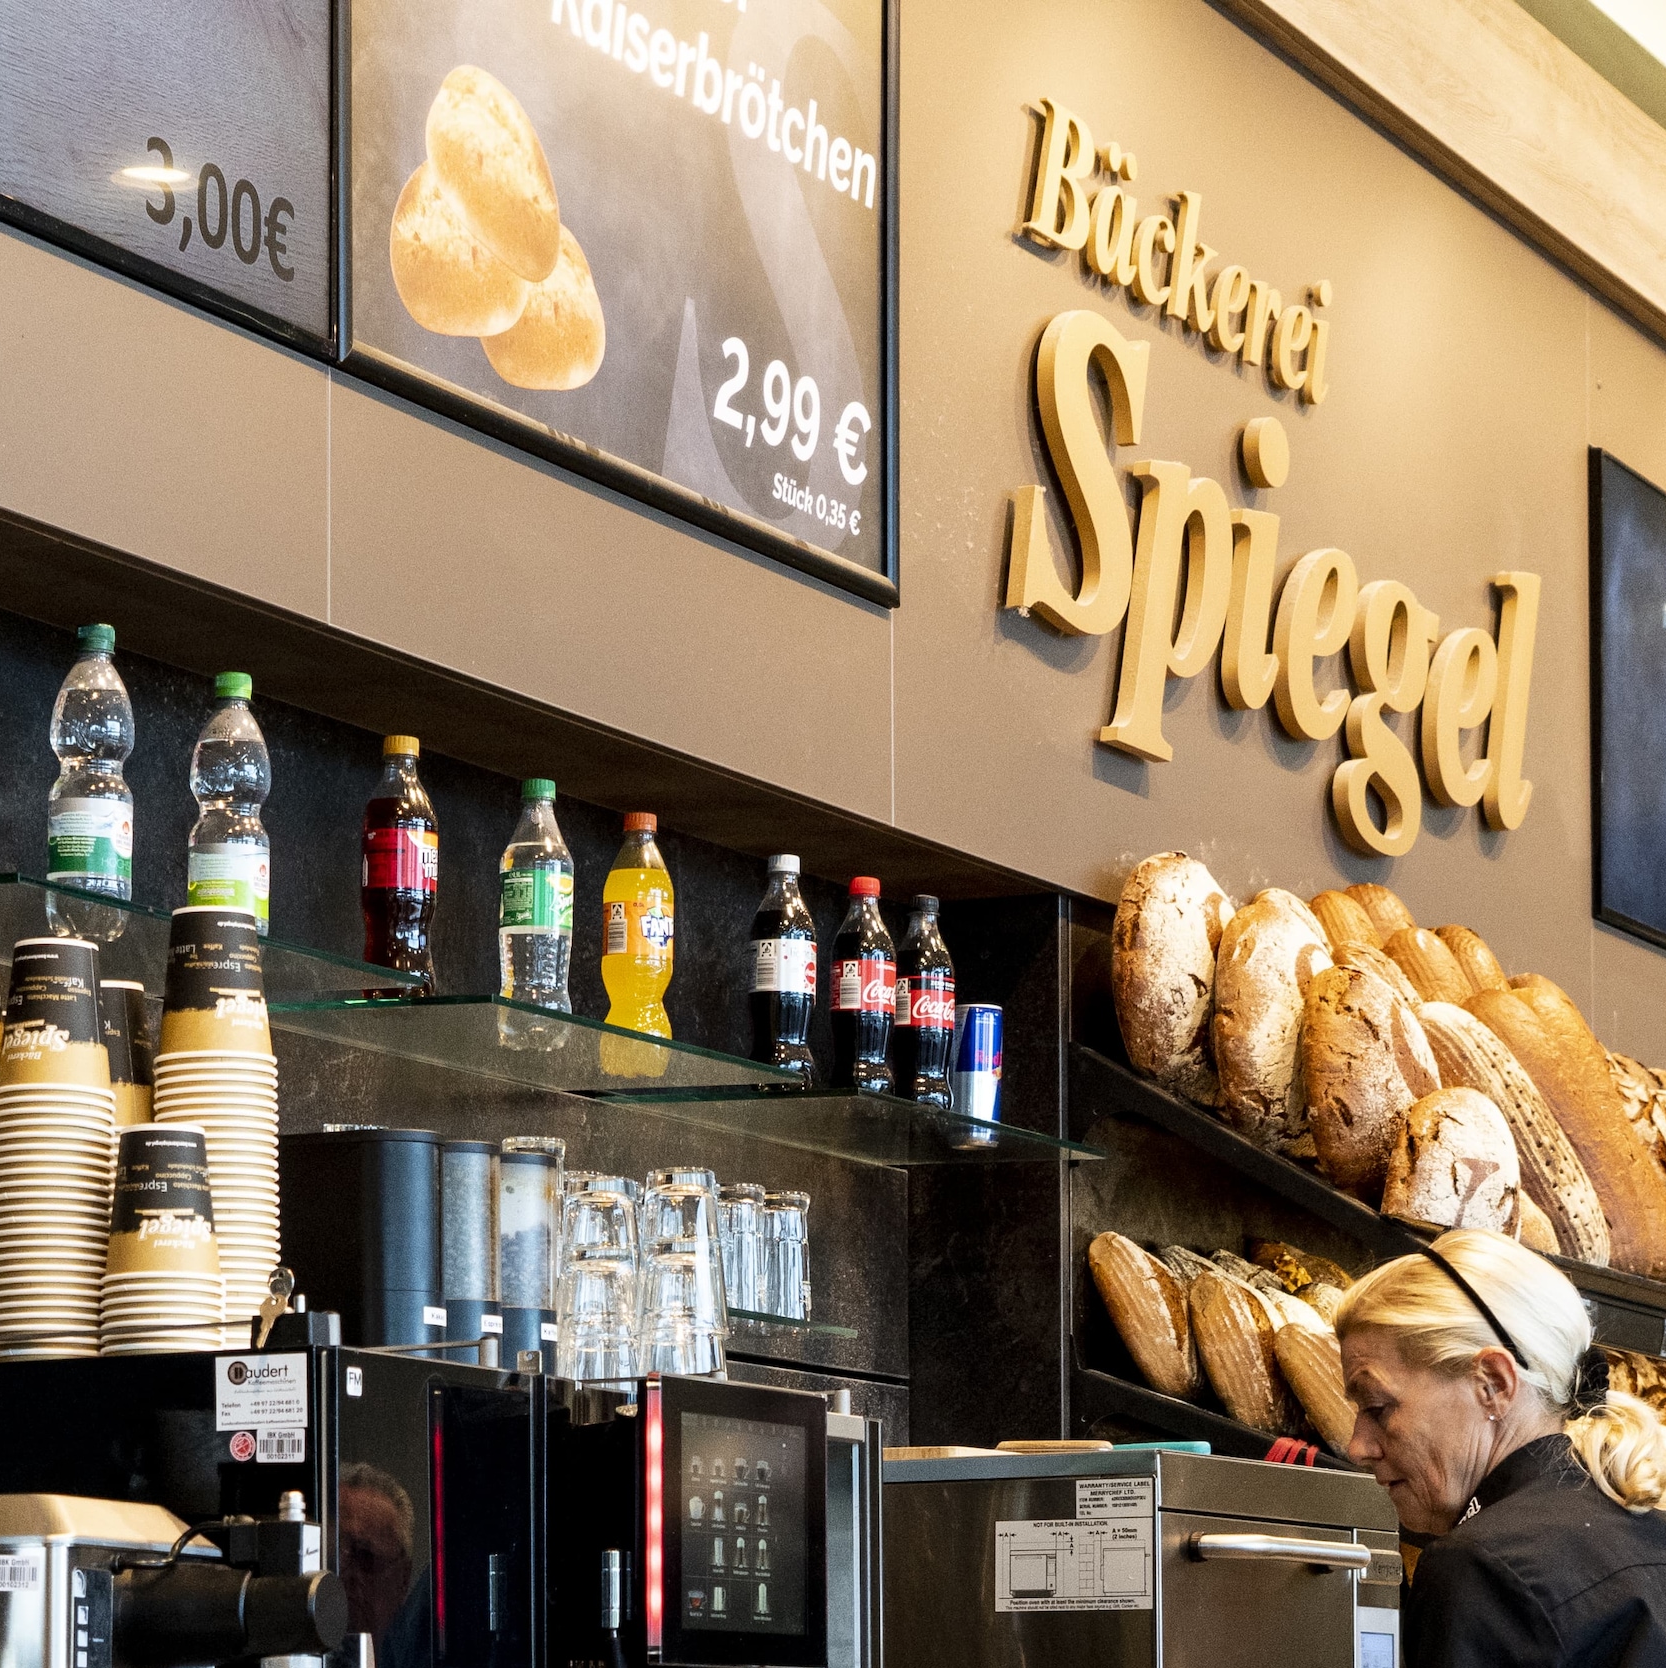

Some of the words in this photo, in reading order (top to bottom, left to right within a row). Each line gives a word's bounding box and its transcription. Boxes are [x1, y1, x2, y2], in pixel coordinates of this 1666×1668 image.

[1020, 96, 1333, 405] Bäckerei
[713, 336, 821, 462] 2,99
[833, 401, 873, 486] €
[772, 473, 813, 518] Stück
[815, 495, 847, 530] 0,35
[848, 509, 861, 537] €
[1006, 309, 1541, 858] Spiegel
[1, 1025, 70, 1057] Spiegel
[155, 1172, 192, 1181] Cappuccino
[349, 1372, 362, 1387] FM
[1079, 1481, 1132, 1489] WARRANTY/SERVICE
